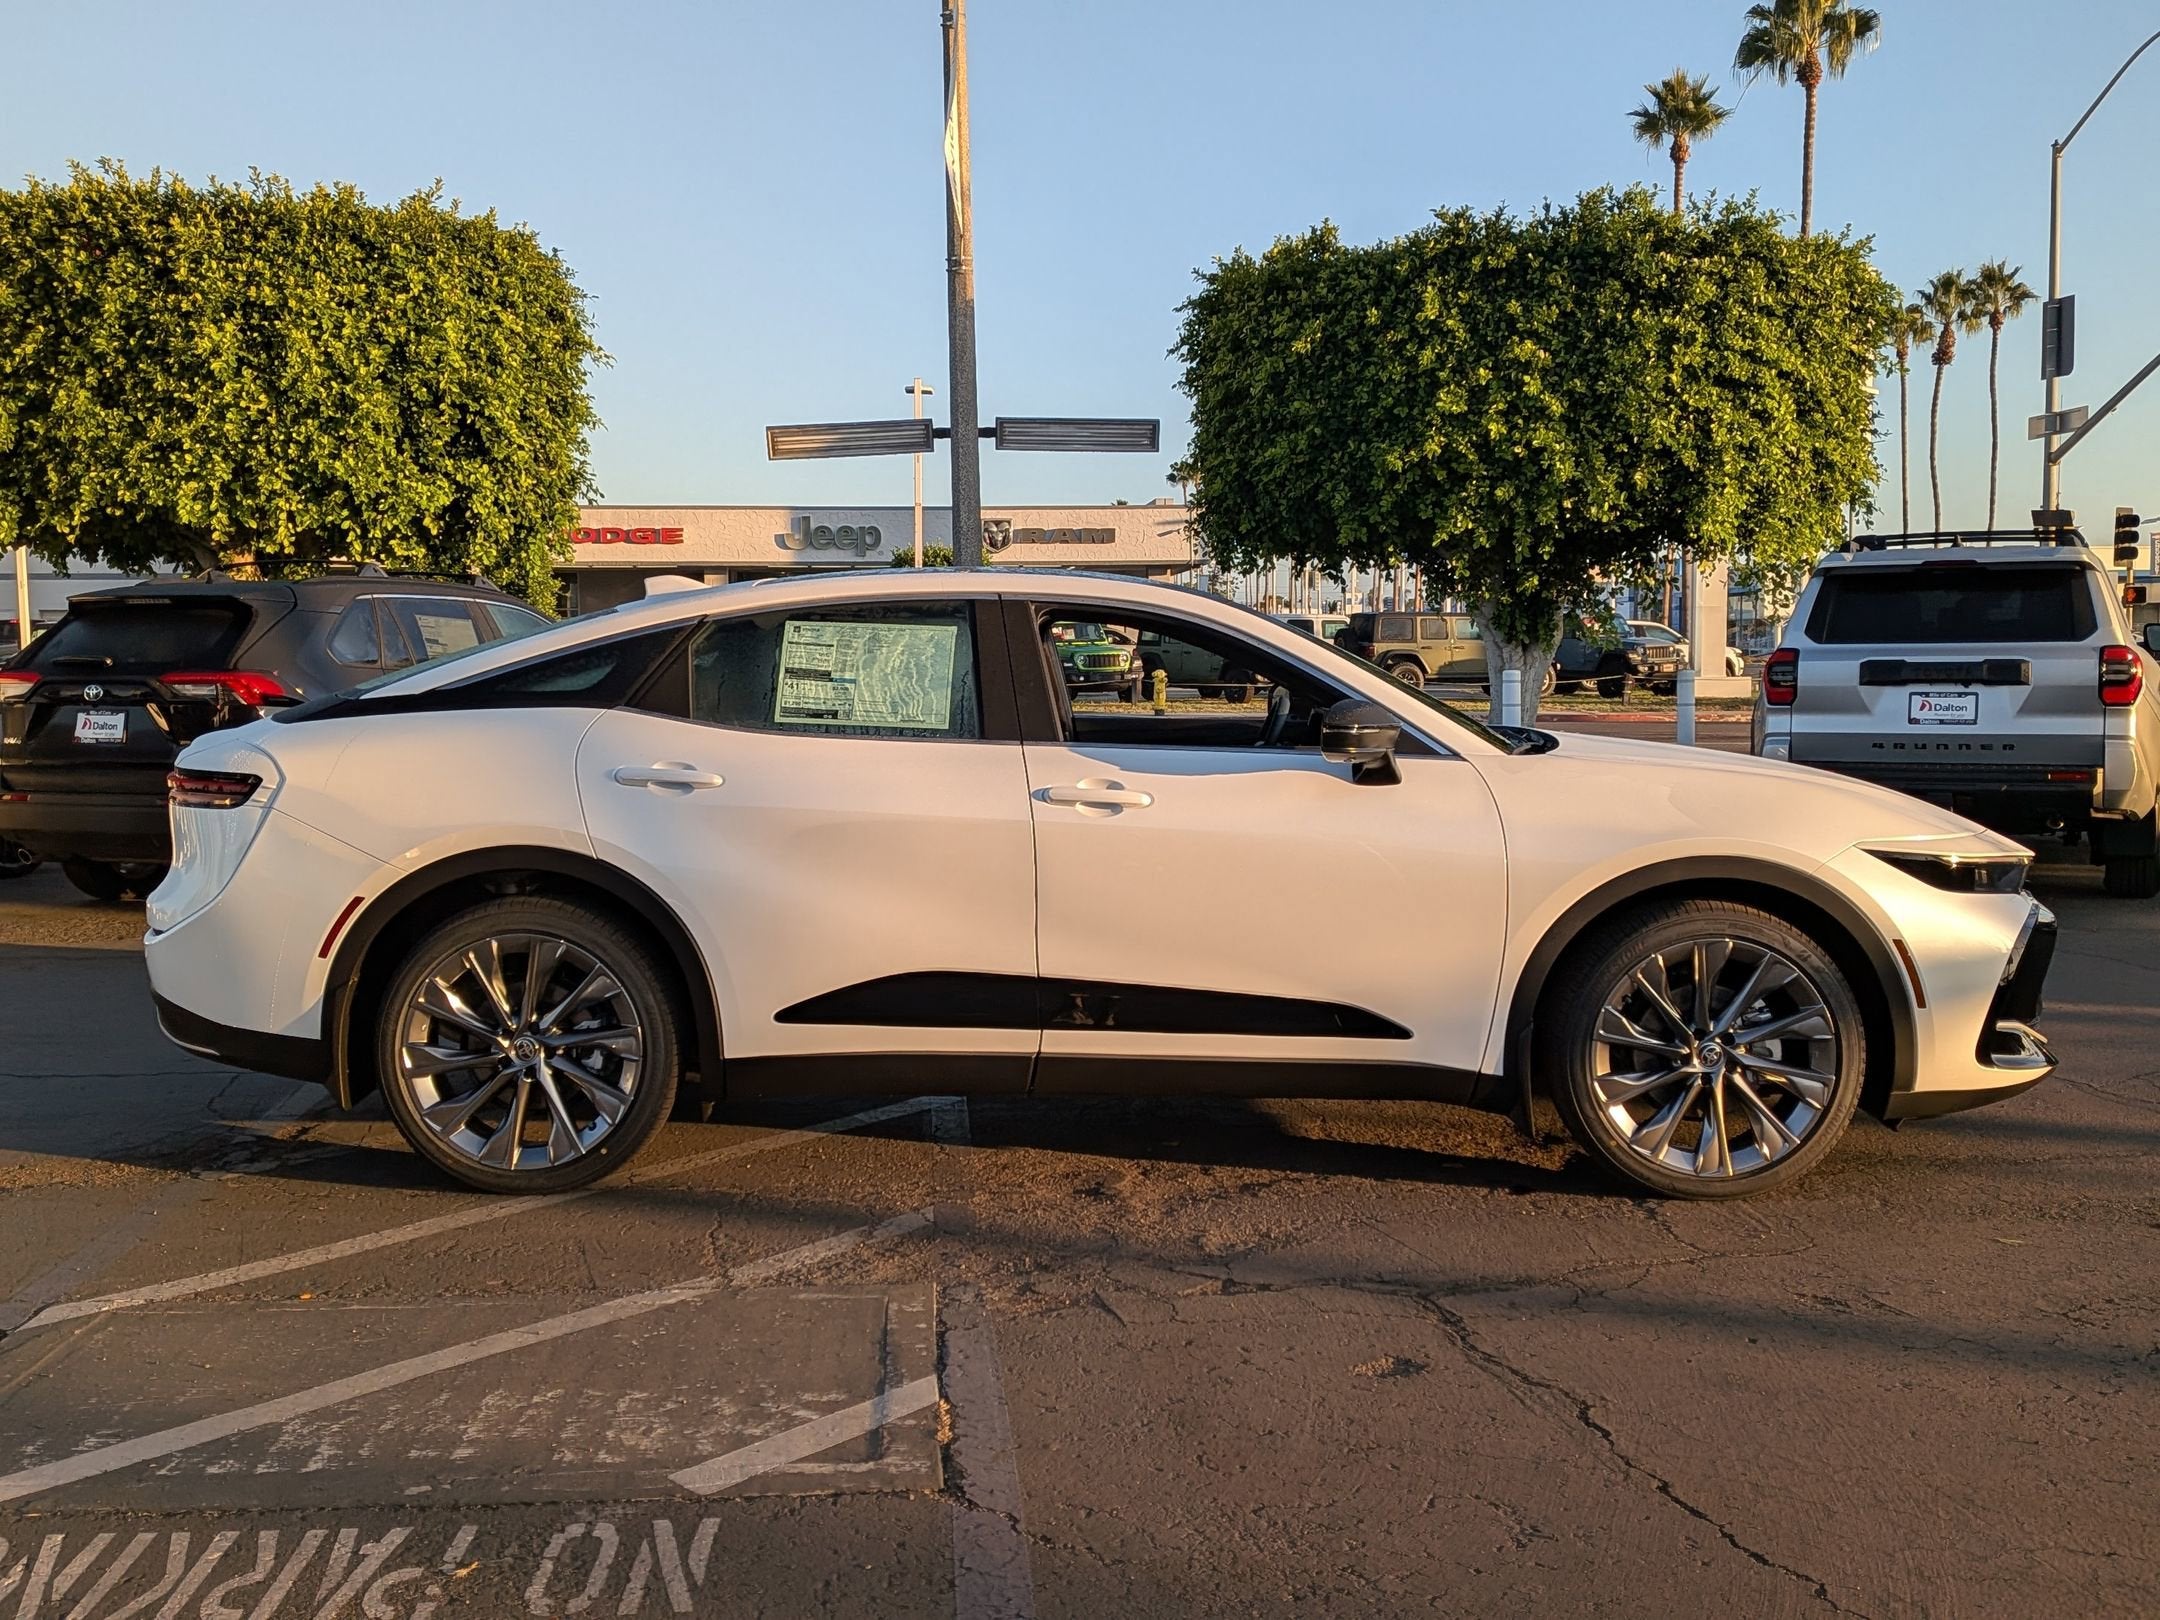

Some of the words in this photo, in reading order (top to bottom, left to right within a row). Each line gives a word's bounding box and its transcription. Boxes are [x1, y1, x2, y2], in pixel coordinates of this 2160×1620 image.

[570, 527, 684, 544] ODGE
[783, 515, 882, 557] Jeep
[1016, 528, 1116, 544] RAM
[1934, 703, 1968, 712] Dalton
[93, 721, 118, 731] Dalton
[1872, 742, 2016, 750] 4RUNNER
[0, 1526, 479, 1620] PARKIN
[524, 1517, 721, 1616] NO
